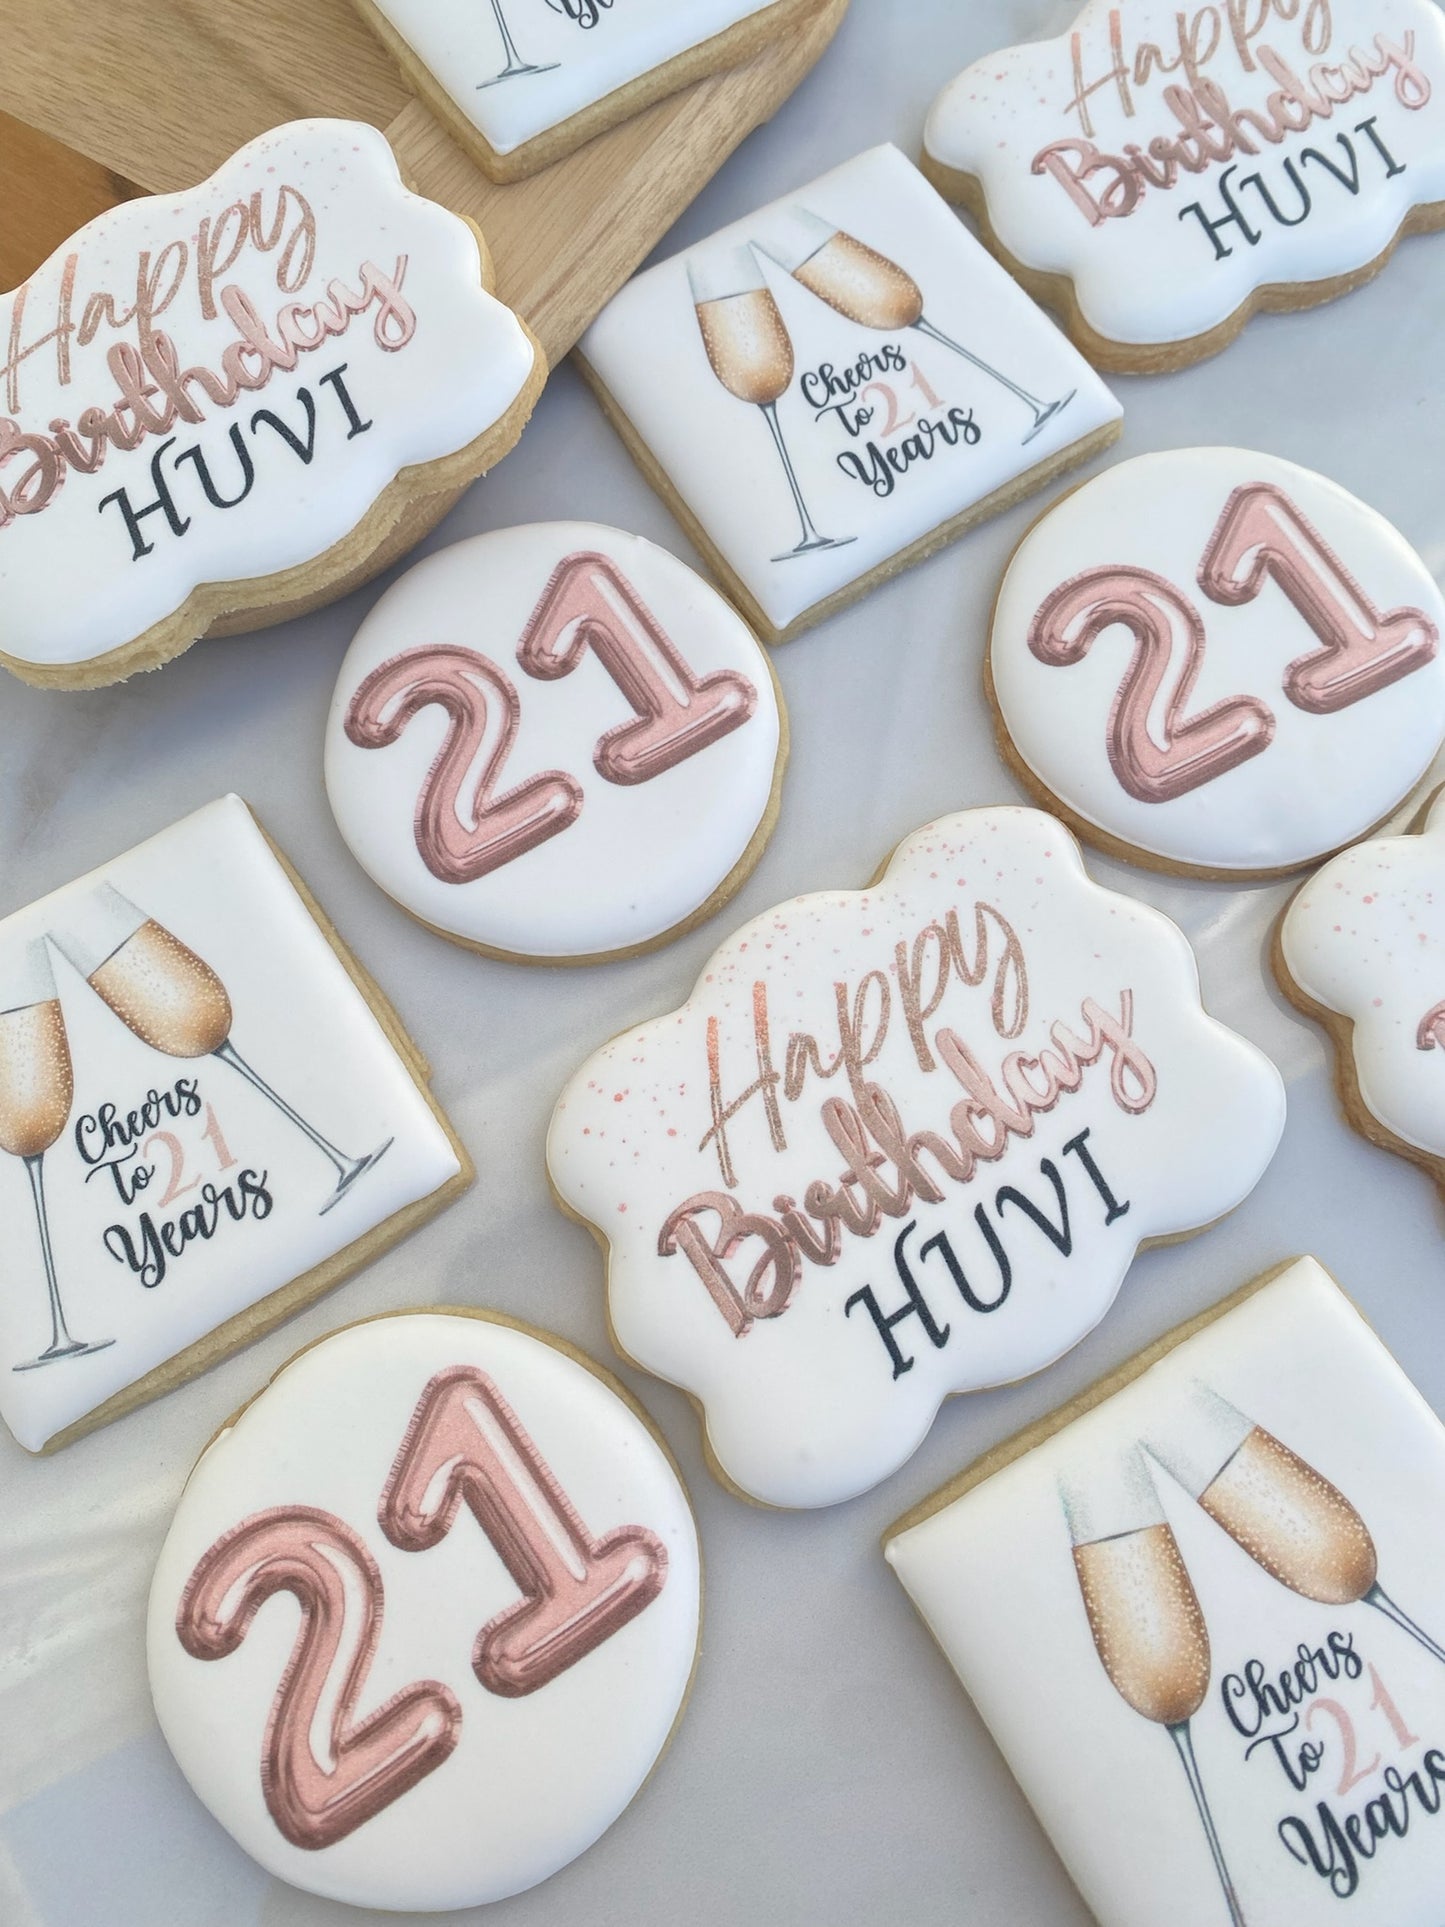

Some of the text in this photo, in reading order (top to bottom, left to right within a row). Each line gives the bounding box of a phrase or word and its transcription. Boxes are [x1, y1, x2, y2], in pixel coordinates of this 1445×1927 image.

[1031, 29, 1432, 228] Birthday
[1064, 0, 1332, 138] Happy
[1178, 116, 1407, 262] HUVI
[0, 184, 317, 416] Happy
[800, 344, 907, 409] Cheers
[814, 361, 946, 438] To 21
[99, 363, 374, 562] HUVI
[836, 407, 982, 498] Years
[1027, 481, 1440, 804] 21
[343, 550, 758, 884] 21
[699, 901, 1029, 1190] Happy
[75, 1078, 202, 1165] Cheers
[84, 1101, 239, 1209] To 21
[657, 987, 1158, 1340] Birthday
[102, 1169, 274, 1289] Years
[844, 1126, 1131, 1382] HUVI
[175, 1364, 669, 1851] 21
[1220, 1631, 1363, 1738] Cheers
[1244, 1661, 1421, 1797] To 21
